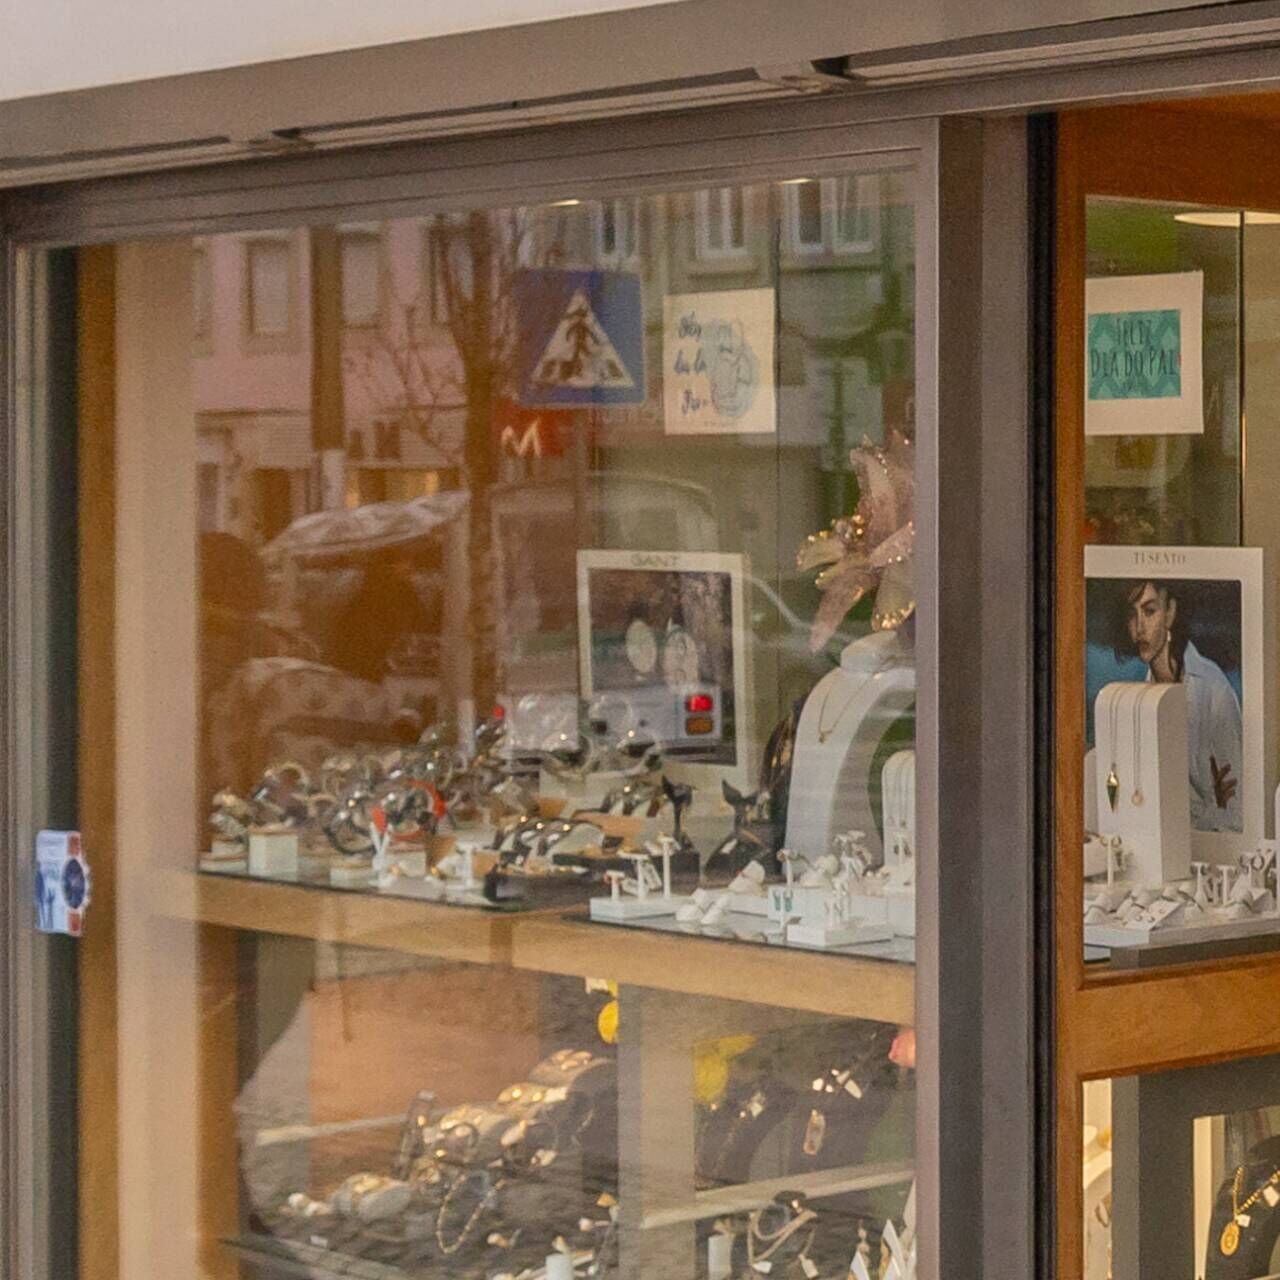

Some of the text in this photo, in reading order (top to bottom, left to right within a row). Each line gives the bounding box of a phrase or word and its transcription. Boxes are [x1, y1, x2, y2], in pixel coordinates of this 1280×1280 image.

[1090, 345, 1177, 378] DIA DO PAI
